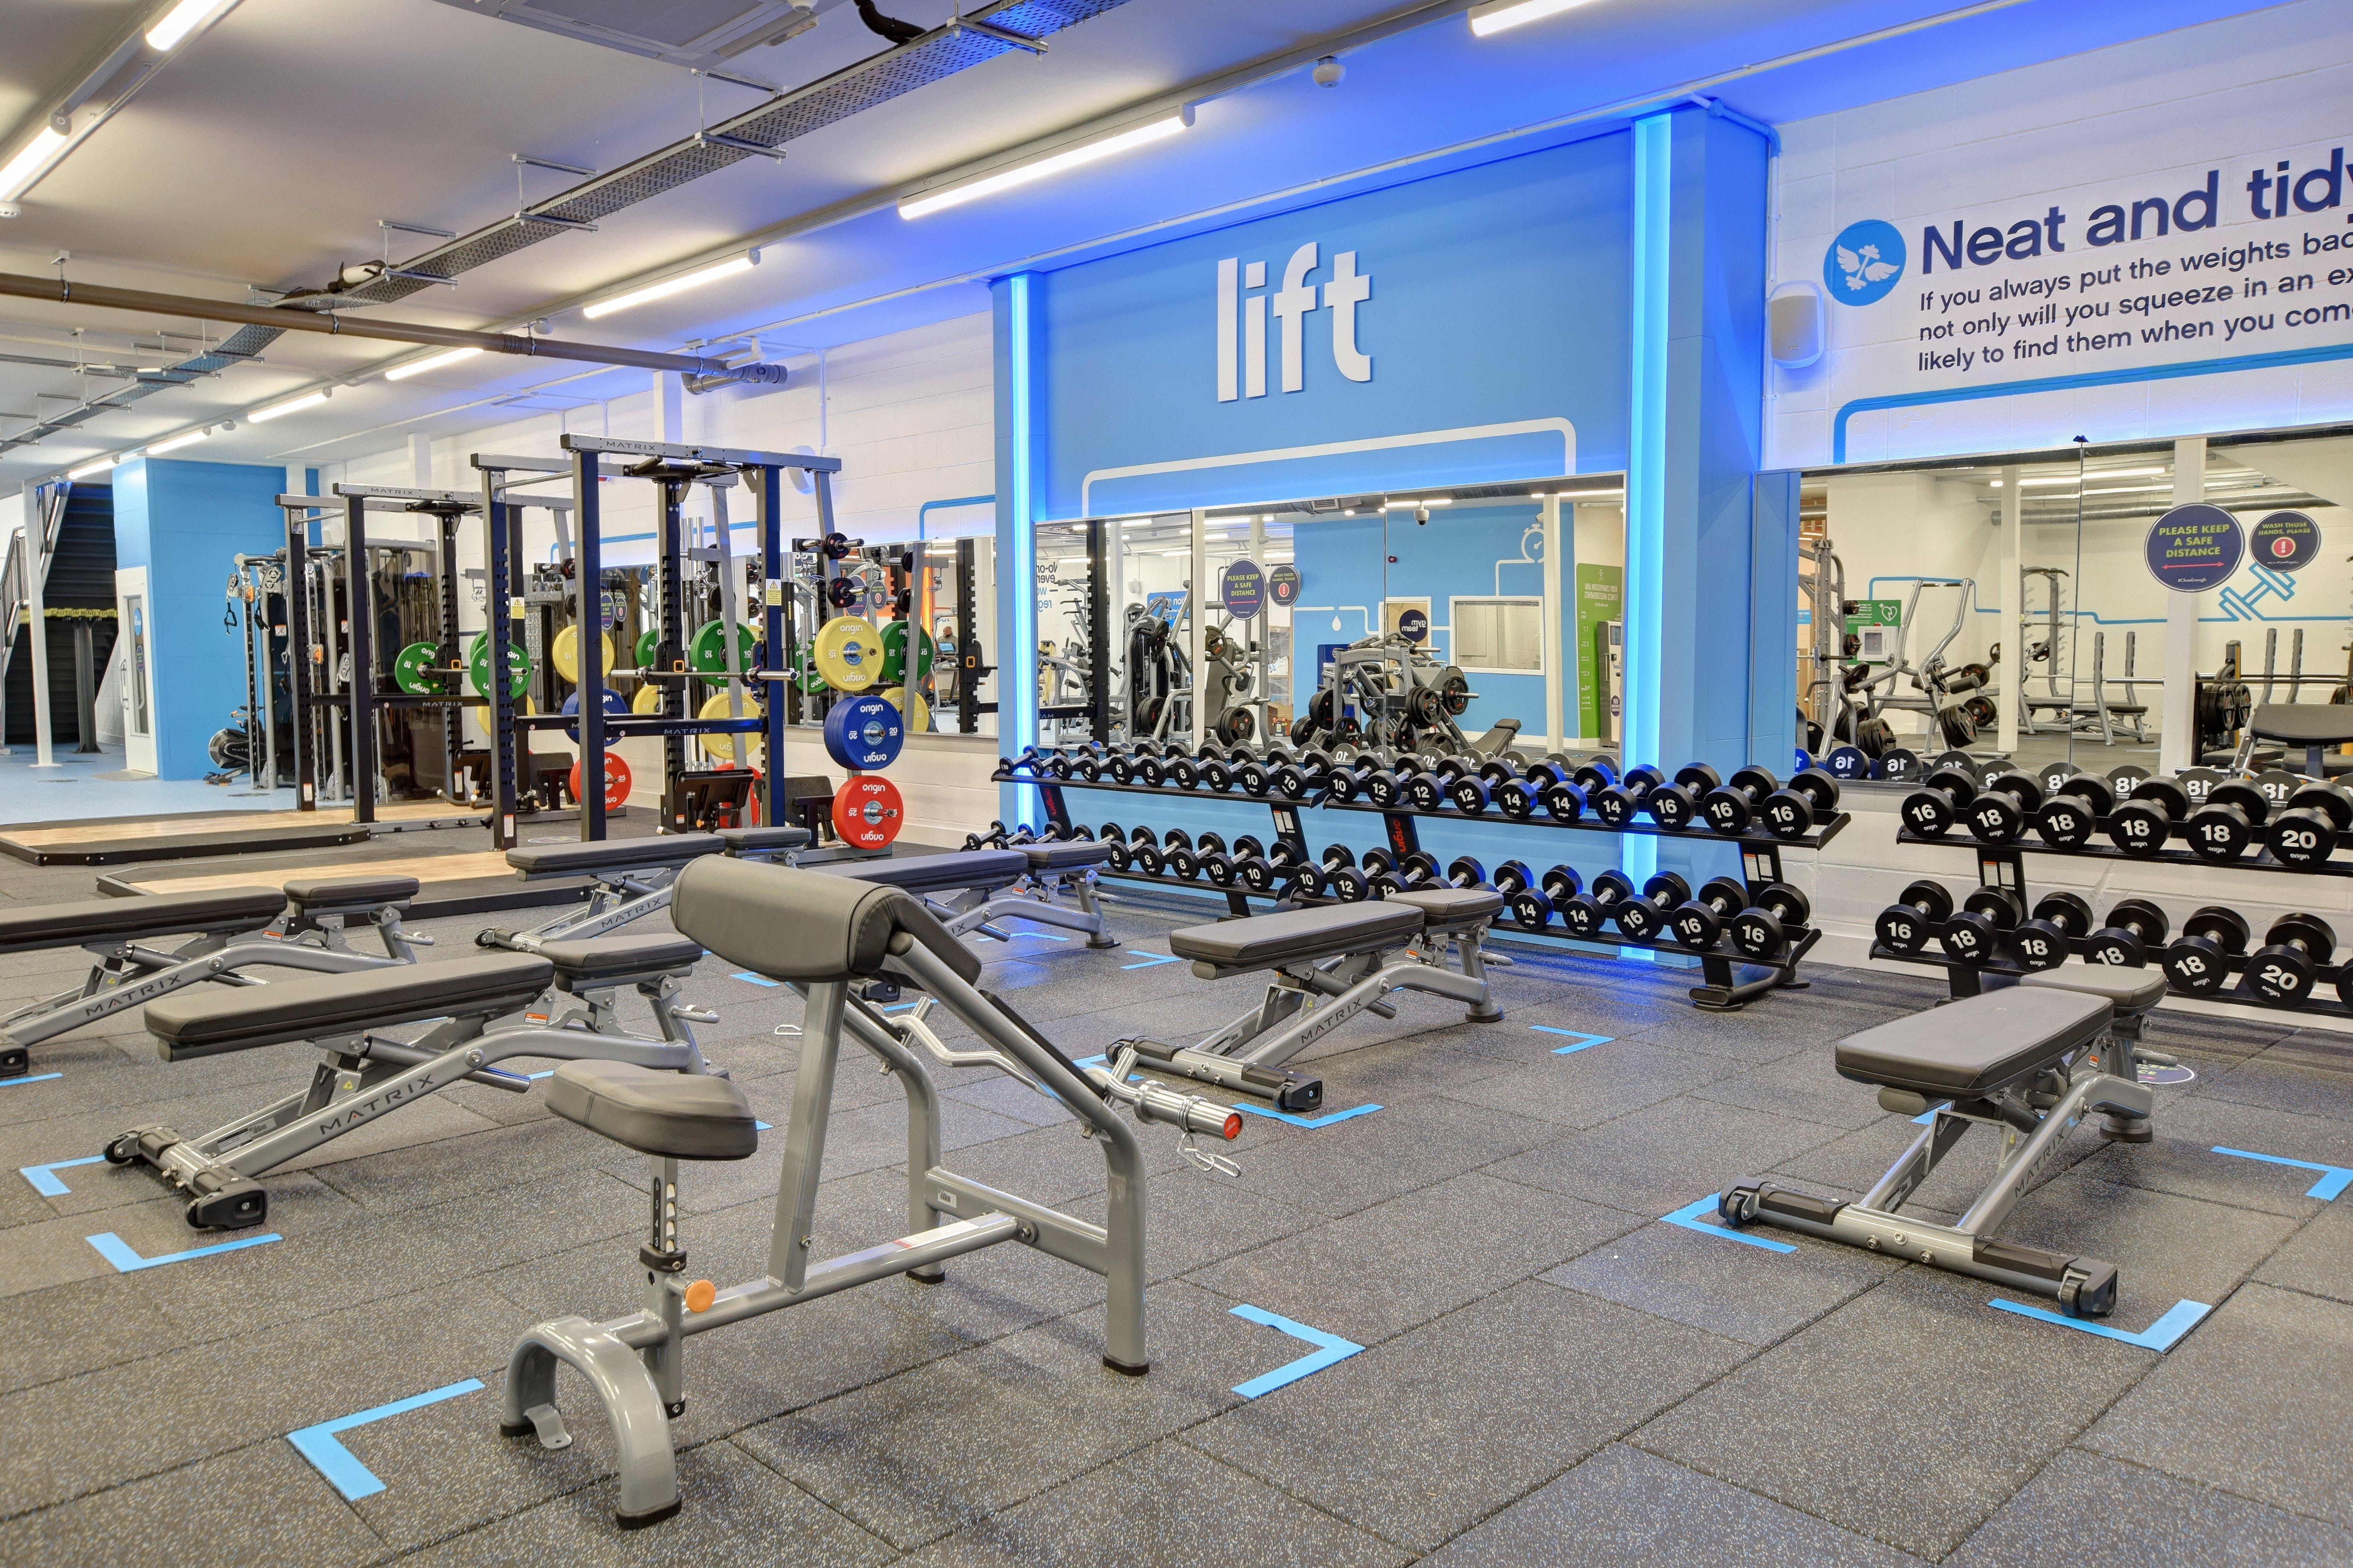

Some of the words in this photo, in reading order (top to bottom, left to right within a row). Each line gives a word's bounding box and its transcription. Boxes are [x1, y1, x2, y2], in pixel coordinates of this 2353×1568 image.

[1923, 206, 2065, 274] Neat
[2087, 169, 2218, 246] and
[1921, 291, 1933, 310] If
[1941, 290, 1979, 314] you
[1989, 276, 2070, 300] always
[2081, 264, 2121, 293] put
[2129, 258, 2170, 279] the
[2180, 241, 2289, 272] weights
[1920, 321, 1954, 341] not
[1963, 312, 2010, 336] only
[2018, 304, 2056, 327] will
[2065, 302, 2109, 327] you
[2119, 286, 2233, 316] squeeze
[2244, 278, 2266, 298] in
[2278, 275, 2313, 293] an
[1217, 241, 1373, 402] lift
[1919, 347, 1975, 371] likely
[1982, 347, 2003, 363] to
[2014, 335, 2057, 359] find
[2067, 332, 2130, 352] them
[2141, 320, 2213, 343] when
[2224, 314, 2273, 341] you
[2285, 304, 2353, 326] com
[606, 441, 655, 450] MATRIX
[2159, 526, 2198, 535] PLEASE
[2202, 524, 2230, 533] KEEP
[2174, 538, 2182, 546] A
[2186, 536, 2213, 545] SAFE
[2166, 547, 2220, 558] DISTANCE
[840, 625, 863, 635] origin
[421, 647, 435, 659] orig
[829, 649, 837, 658] 15
[843, 672, 866, 681] origin
[409, 682, 430, 694] origin
[860, 704, 883, 715] origin
[849, 730, 857, 740] 20
[889, 726, 898, 735] 20
[863, 751, 887, 763] origin
[1116, 764, 1122, 774] 6
[1147, 766, 1153, 776] 6
[1179, 769, 1186, 779] 8
[1212, 771, 1219, 781] 8
[1245, 774, 1258, 785] 10
[1283, 775, 1296, 790] 10
[862, 784, 885, 794] origin
[1333, 779, 1346, 792] 10
[1373, 783, 1387, 796] 12
[1414, 786, 1429, 798] 12
[1458, 789, 1475, 802] 12
[1505, 794, 1521, 806] 14
[1553, 797, 1570, 809] 14
[1604, 800, 1621, 813] 14
[1656, 799, 1677, 813] 16
[848, 808, 857, 816] 25
[1711, 802, 1733, 818] 16
[1771, 806, 1794, 822] 16
[1912, 804, 1936, 821] 16
[1977, 810, 2002, 827] 18
[2048, 814, 2075, 831] 18
[2122, 820, 2150, 836] 18
[2201, 825, 2230, 842] 18
[861, 830, 884, 841] origin
[2282, 830, 2316, 848] 20
[1113, 851, 1119, 861] 6
[1145, 855, 1152, 865] 8
[1178, 859, 1186, 869] 8
[1210, 864, 1223, 875] 10
[1248, 868, 1260, 879] 10
[1300, 873, 1314, 885] 10
[1339, 880, 1354, 893] 12
[1382, 885, 1397, 896] 12
[601, 897, 662, 928] MATRIX
[1519, 904, 1536, 916] 14
[1570, 910, 1588, 923] 14
[1624, 910, 1643, 928] 16
[1679, 918, 1701, 934] 16
[1888, 922, 1911, 939] 16
[1743, 925, 1764, 942] 16
[1950, 930, 1976, 949] 18
[2021, 939, 2048, 955] 18
[2094, 947, 2124, 966] 18
[2175, 956, 2206, 976] 18
[2260, 965, 2297, 991] 20
[85, 973, 181, 1016] MATRIX
[2262, 984, 2281, 997] origin
[1301, 998, 1362, 1044] MATRIX
[320, 1073, 435, 1134] MATRIX
[2013, 1128, 2067, 1197] MATRIX
[656, 1181, 659, 1191] 6
[655, 1199, 658, 1209] 5
[655, 1219, 658, 1228] 4
